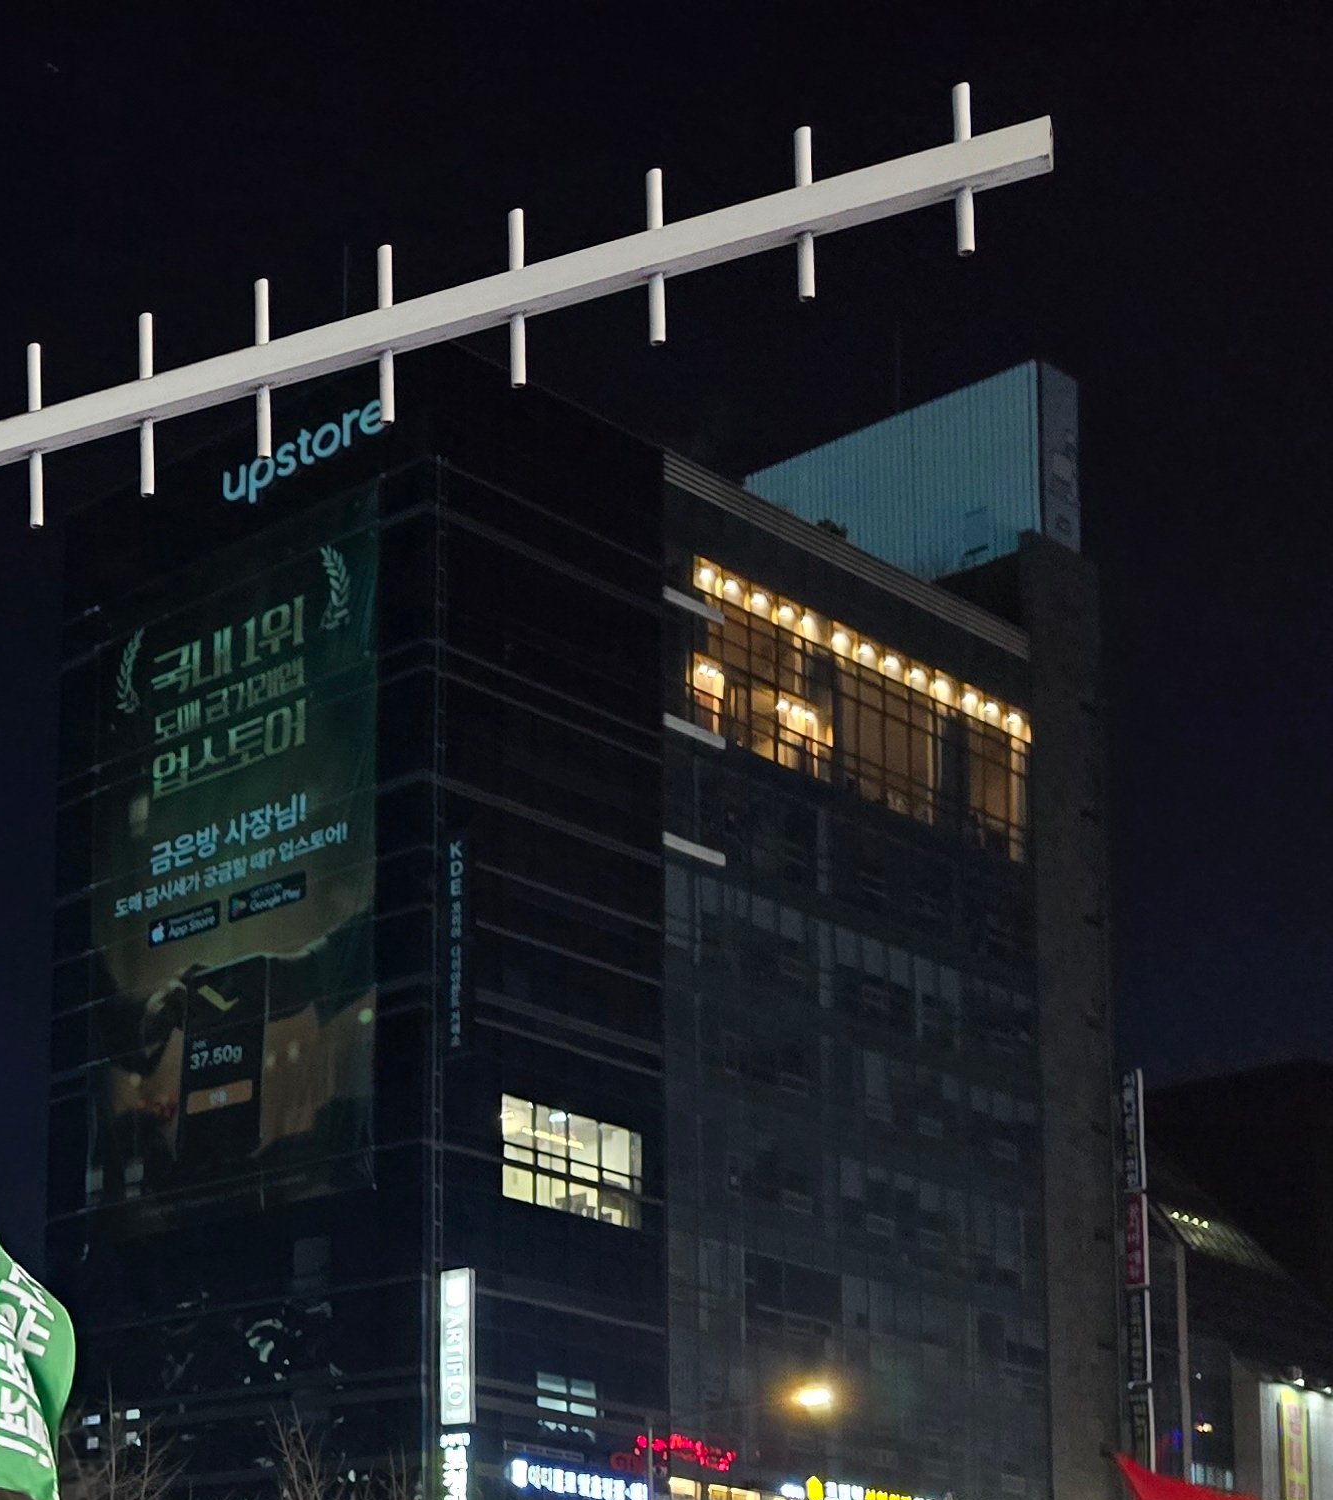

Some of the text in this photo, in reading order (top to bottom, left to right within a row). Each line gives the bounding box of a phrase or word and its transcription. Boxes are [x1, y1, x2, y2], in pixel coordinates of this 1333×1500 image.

[222, 399, 384, 504] upstore
[150, 594, 305, 694] 국내 1위
[152, 697, 306, 799] 업스토어
[153, 698, 202, 745] 도매
[150, 792, 308, 876] 금은방 사장님!
[449, 840, 464, 897] KDE
[190, 1042, 243, 1069] 37.50g
